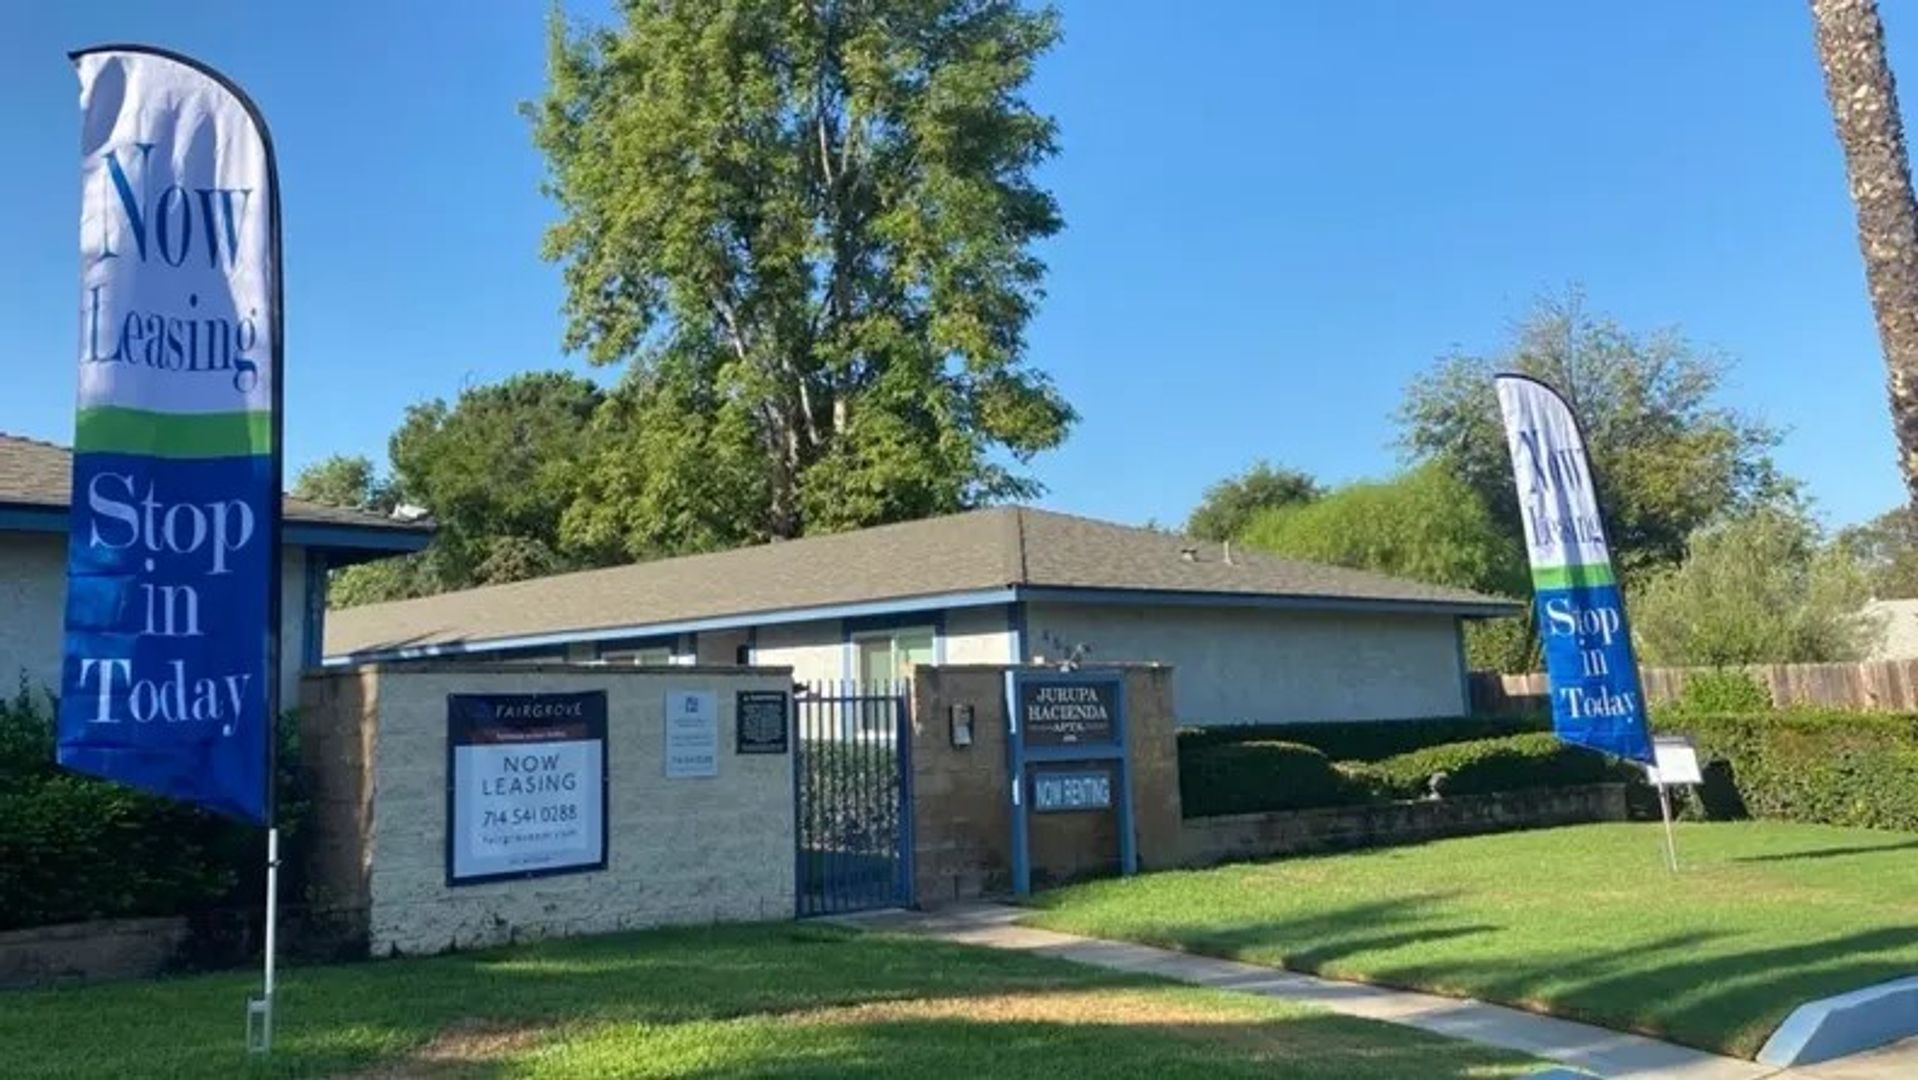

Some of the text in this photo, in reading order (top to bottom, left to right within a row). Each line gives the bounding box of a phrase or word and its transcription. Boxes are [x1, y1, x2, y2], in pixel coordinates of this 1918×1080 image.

[99, 142, 254, 270] Now
[81, 284, 259, 393] Leasing
[88, 472, 255, 575] Stop
[139, 558, 205, 637] in
[1546, 598, 1620, 646] Stop
[1578, 639, 1608, 677] in
[79, 658, 253, 737] Today
[496, 702, 583, 718] FAIRGROVE
[1028, 704, 1108, 721] HACIENDA
[1036, 687, 1098, 702] JURUPA
[1559, 684, 1636, 724] Today
[504, 755, 560, 773] NOW
[482, 772, 577, 796] LEASING
[1036, 777, 1110, 806] NOW RENTING
[482, 804, 577, 828] 714 541 0288
